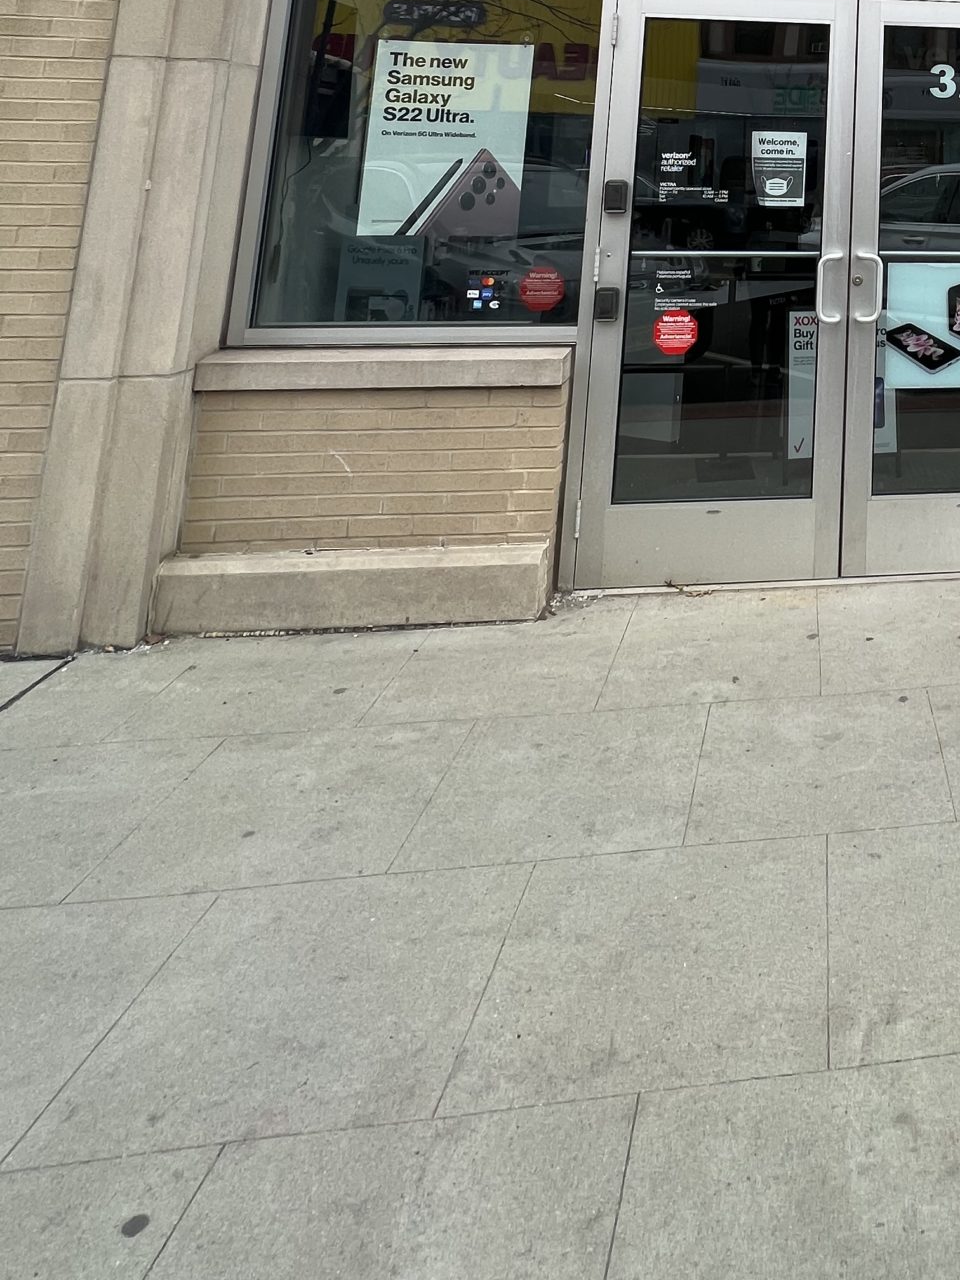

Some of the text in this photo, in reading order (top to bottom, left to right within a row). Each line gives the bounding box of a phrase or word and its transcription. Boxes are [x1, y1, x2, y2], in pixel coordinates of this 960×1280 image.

[389, 51, 469, 69] The new
[386, 69, 475, 91] Samsung
[384, 87, 452, 108] Galaxy
[382, 106, 475, 124] S22 Ultra.
[758, 138, 800, 147] Welcome,
[660, 158, 697, 166] authorized
[793, 328, 815, 340] Buy
[793, 340, 814, 351] Gift
